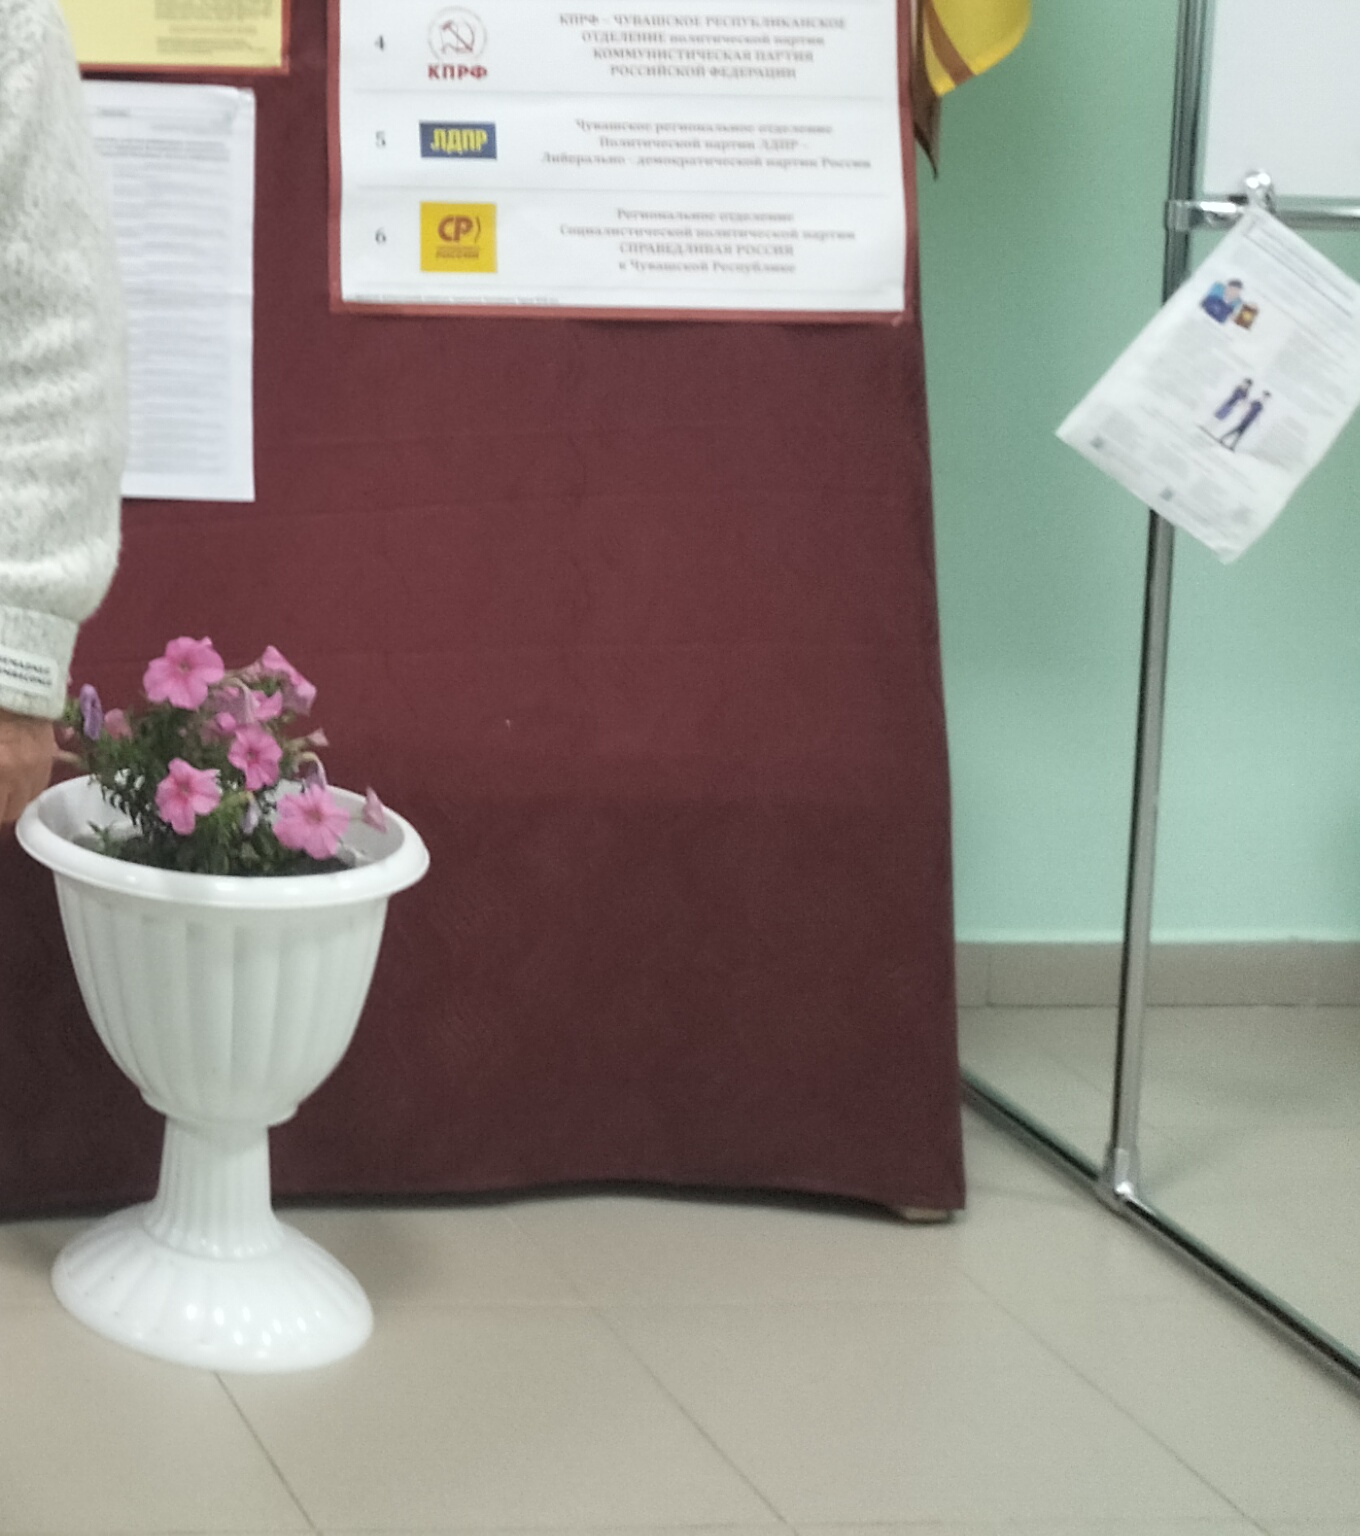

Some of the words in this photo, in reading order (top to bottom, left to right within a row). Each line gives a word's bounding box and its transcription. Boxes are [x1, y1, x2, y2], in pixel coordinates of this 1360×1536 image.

[374, 35, 385, 52] 4
[427, 63, 488, 81] КПРФ
[374, 131, 386, 148] 5
[430, 128, 488, 155] ЛДПР
[374, 228, 387, 245] 6
